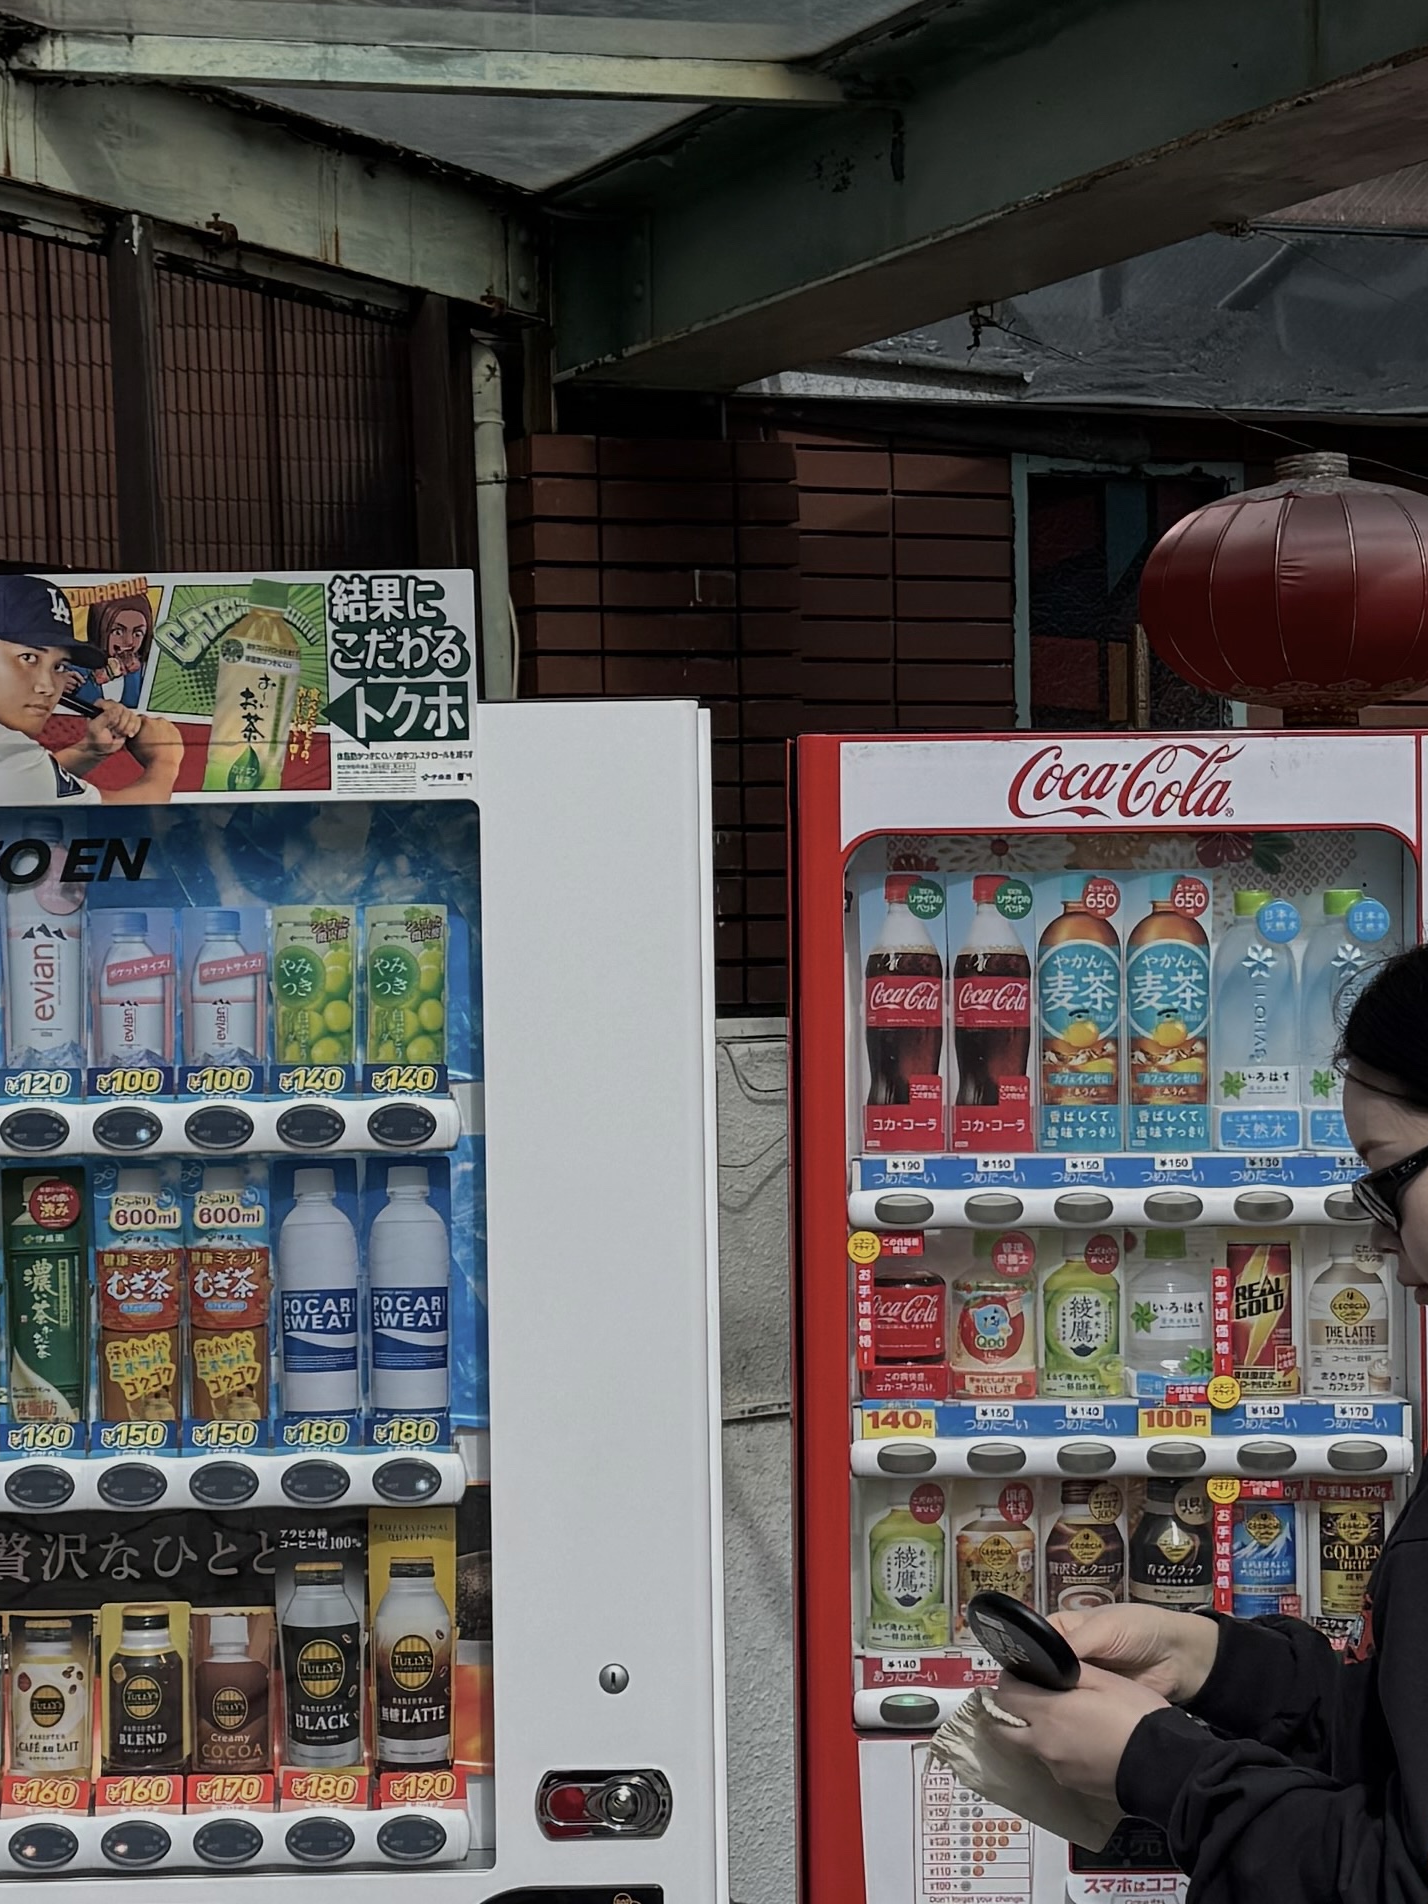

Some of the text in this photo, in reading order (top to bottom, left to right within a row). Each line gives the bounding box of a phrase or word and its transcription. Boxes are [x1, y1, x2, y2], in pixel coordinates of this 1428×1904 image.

[332, 577, 438, 623] 結果に
[334, 625, 462, 671] こだわる
[356, 684, 466, 740] トクホ
[1006, 742, 1246, 820] Coca-Cola
[60, 836, 151, 884] EN
[1085, 892, 1118, 909] 650
[1174, 892, 1206, 909] 650
[30, 943, 56, 1022] evian
[869, 981, 941, 1012] Coca-Cola
[1042, 970, 1118, 1012] 麦茶
[1131, 970, 1208, 1012] 麦茶
[958, 982, 1029, 1012] Coca-Cola
[5, 1068, 71, 1096] ¥120
[96, 1067, 165, 1096] ¥100
[186, 1065, 254, 1094] ¥100
[279, 1065, 346, 1094] ¥140
[371, 1065, 439, 1093] ¥140
[872, 1118, 937, 1132] コカ・コーラ
[1234, 1122, 1288, 1139] 天然水
[114, 1207, 177, 1226] 600ml
[198, 1206, 261, 1225] 600ml
[105, 1266, 174, 1301] むぎ茶
[192, 1265, 260, 1300] むぎ茶
[1235, 1275, 1285, 1303] REAL
[283, 1297, 356, 1313] POCARI
[373, 1296, 446, 1312] POCARI
[1234, 1294, 1285, 1320] GOLD
[284, 1313, 352, 1330] SWEAT
[373, 1311, 442, 1328] SWEAT
[1069, 1296, 1095, 1344] 綾鷹
[1324, 1325, 1377, 1339] THE LATTE
[975, 1334, 1006, 1348] Qoo
[283, 1418, 350, 1446] ¥180
[373, 1417, 440, 1444] ¥180
[866, 1410, 933, 1430] 140円
[1142, 1409, 1207, 1429] 100円
[8, 1422, 76, 1451] ¥160
[100, 1420, 169, 1449] ¥150
[191, 1419, 260, 1448] ¥150
[1322, 1544, 1384, 1560] GOLDEN
[894, 1546, 920, 1592] 綾鷹
[295, 1712, 351, 1731] BLACK
[402, 1704, 446, 1724] LATTE
[118, 1731, 168, 1747] BLEND
[201, 1743, 264, 1759] COCOA
[210, 1733, 251, 1745] Creamy
[10, 1777, 79, 1806] ¥160
[105, 1776, 173, 1804] ¥160
[196, 1774, 264, 1803] ¥170
[290, 1772, 358, 1801] ¥180
[389, 1771, 458, 1800] ¥190
